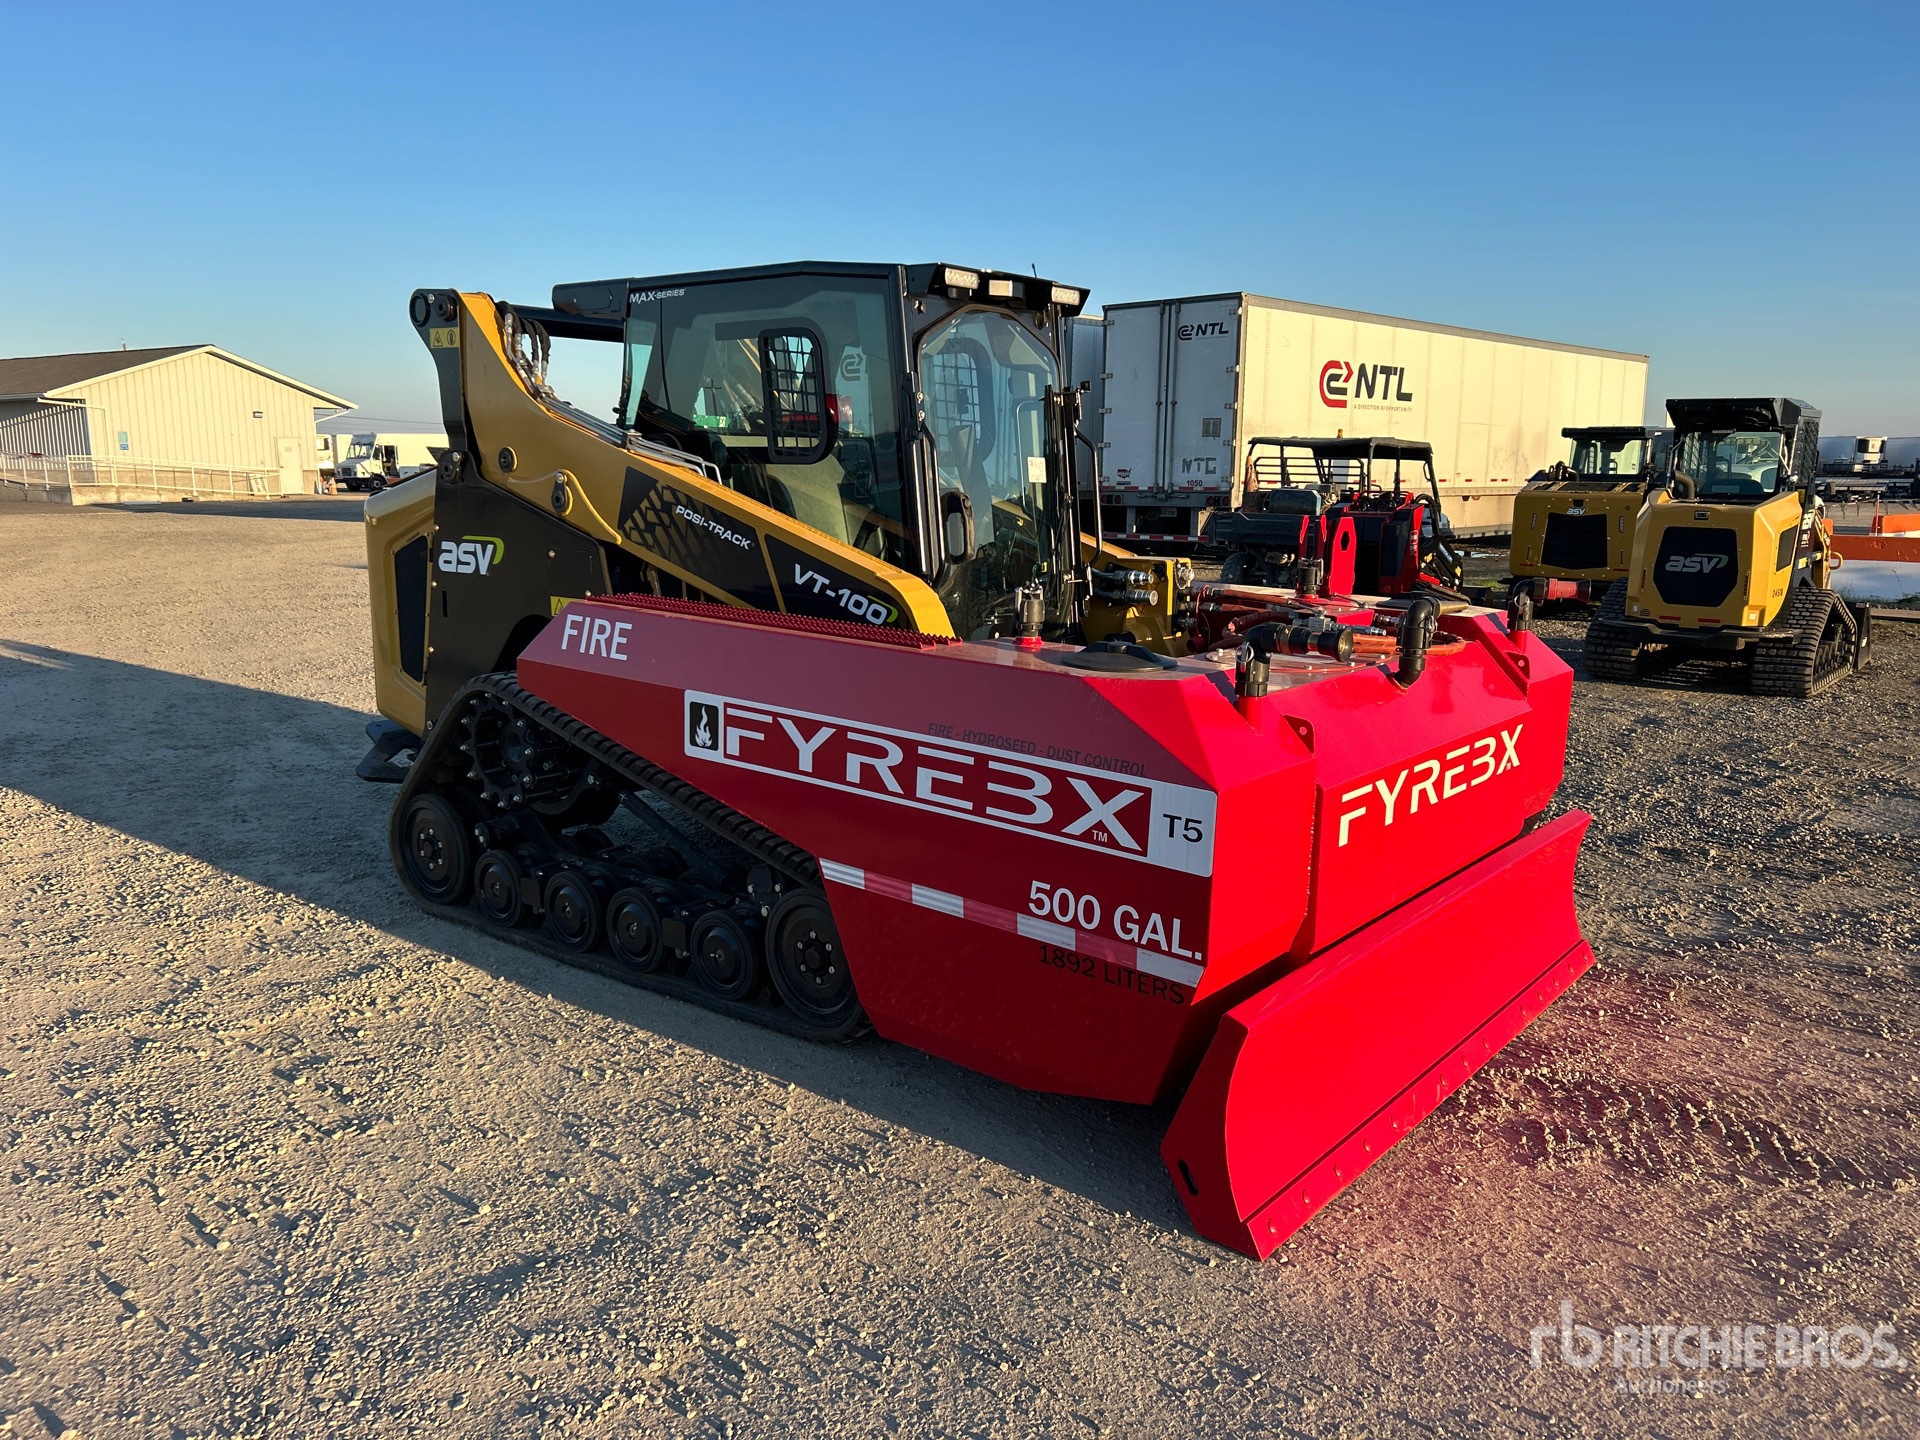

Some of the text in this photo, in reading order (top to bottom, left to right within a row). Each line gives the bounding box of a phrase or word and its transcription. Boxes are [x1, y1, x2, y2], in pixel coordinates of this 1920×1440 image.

[1195, 321, 1230, 336] NTL
[1354, 363, 1414, 402] NTL
[675, 505, 752, 550] POSI-TRACK
[794, 563, 888, 625] VT-100
[561, 614, 633, 661] FIRE
[928, 723, 1148, 779] FIRE HYDROSEED DUST CONTROL
[1092, 829, 1108, 843] TM
[1162, 813, 1203, 843] T5
[1029, 880, 1202, 961] 500 GAL.
[1039, 944, 1185, 1005] 1892 LITERS
